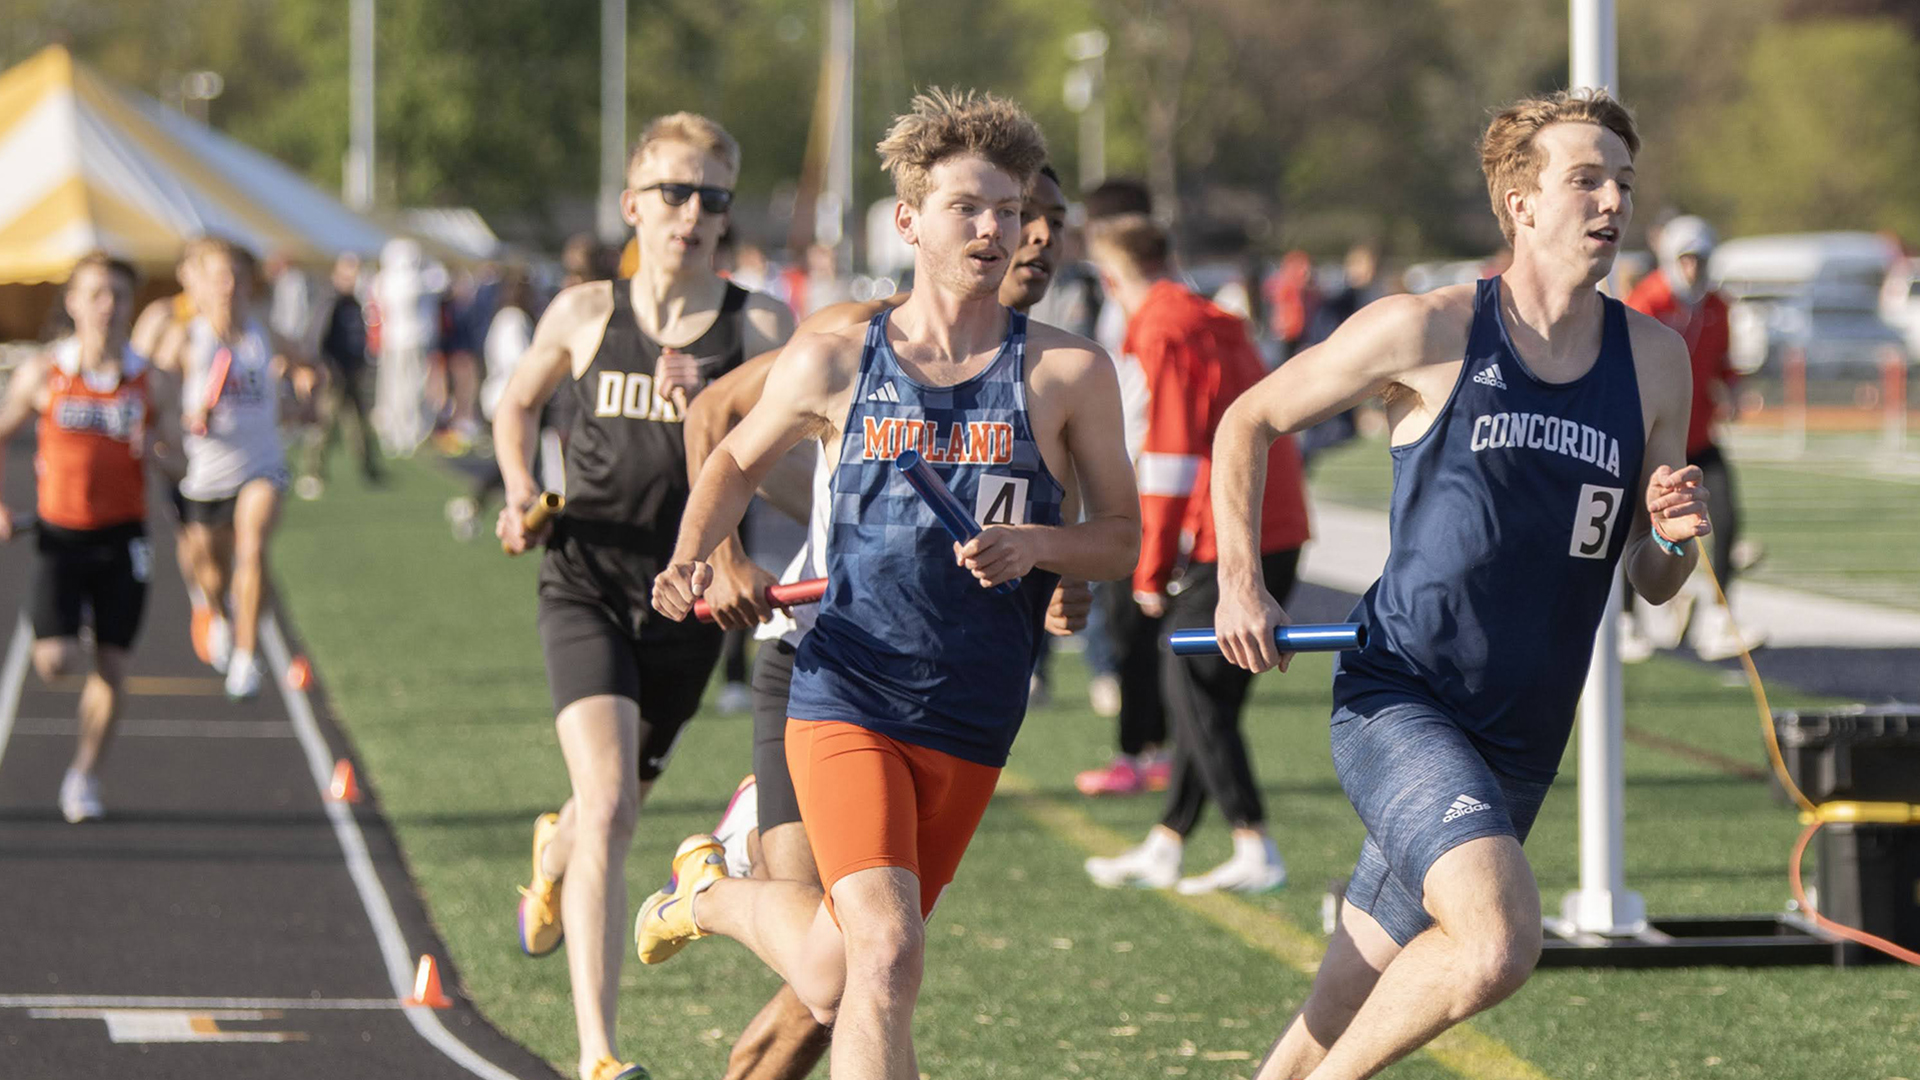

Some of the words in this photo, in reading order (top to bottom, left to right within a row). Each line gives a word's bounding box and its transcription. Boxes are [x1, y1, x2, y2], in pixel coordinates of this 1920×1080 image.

[1473, 375, 1507, 390] adidas
[863, 416, 1014, 465] MIDLAND
[1470, 412, 1620, 478] CONCORDIA
[983, 482, 1016, 526] 4
[1579, 491, 1615, 555] 3
[1442, 802, 1492, 823] adidas
